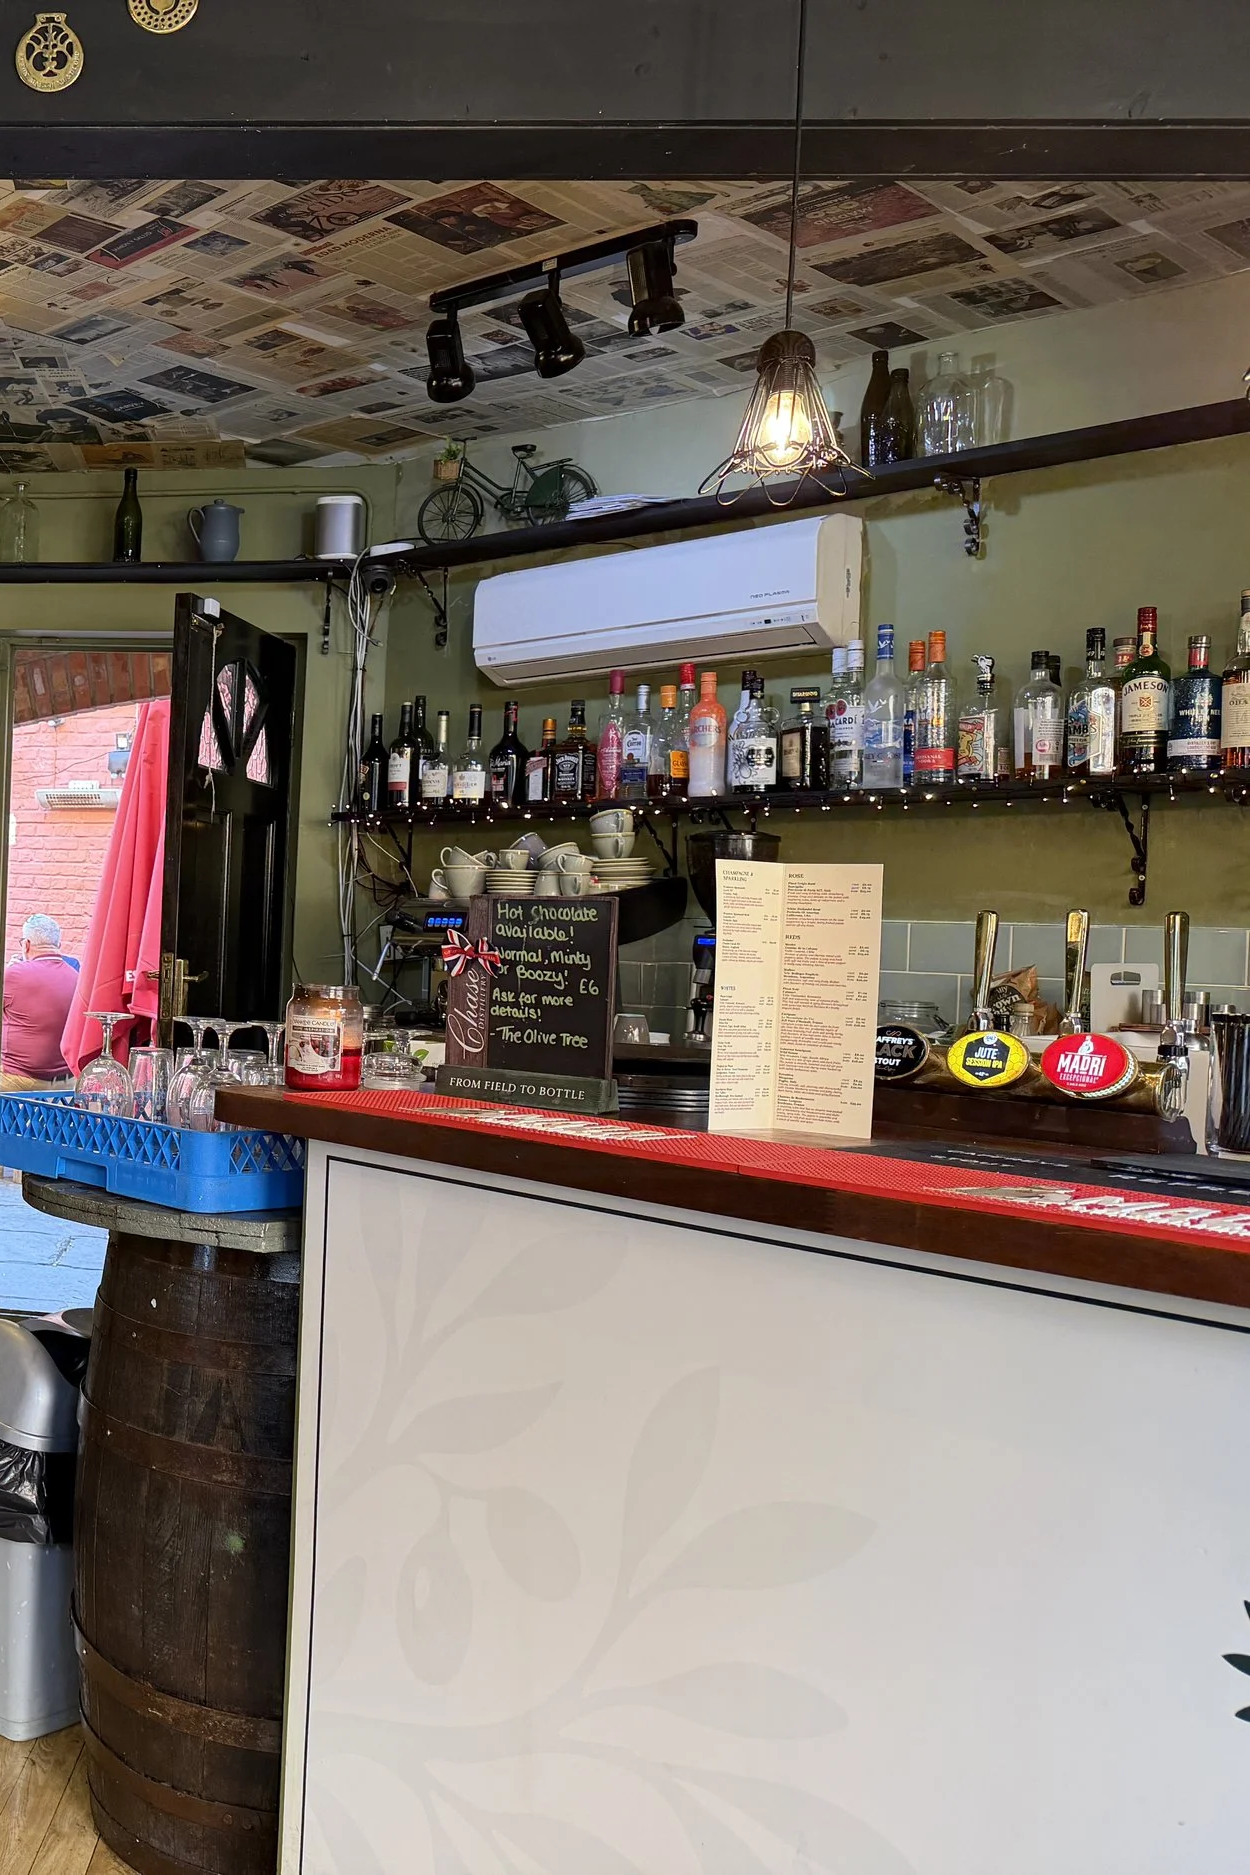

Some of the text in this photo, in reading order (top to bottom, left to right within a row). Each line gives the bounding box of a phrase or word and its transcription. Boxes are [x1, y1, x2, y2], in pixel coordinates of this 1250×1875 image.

[1123, 681, 1169, 696] JAMESON
[497, 903, 524, 921] Hot
[496, 924, 576, 944] available!
[550, 949, 592, 971] Minty
[516, 966, 570, 990] Boozy!
[478, 974, 488, 1030] DISTILLERY
[492, 987, 574, 1007] Ask for more
[448, 967, 485, 1060] Chase
[490, 1004, 542, 1022] details!
[523, 1028, 557, 1045] Olive
[560, 1032, 589, 1049] Tree
[876, 1044, 918, 1059] ACK
[974, 1046, 999, 1059] JUTE
[965, 1057, 1003, 1069] SESSION IPA
[449, 1077, 586, 1100] FROM FIELD TO BOTTLE
